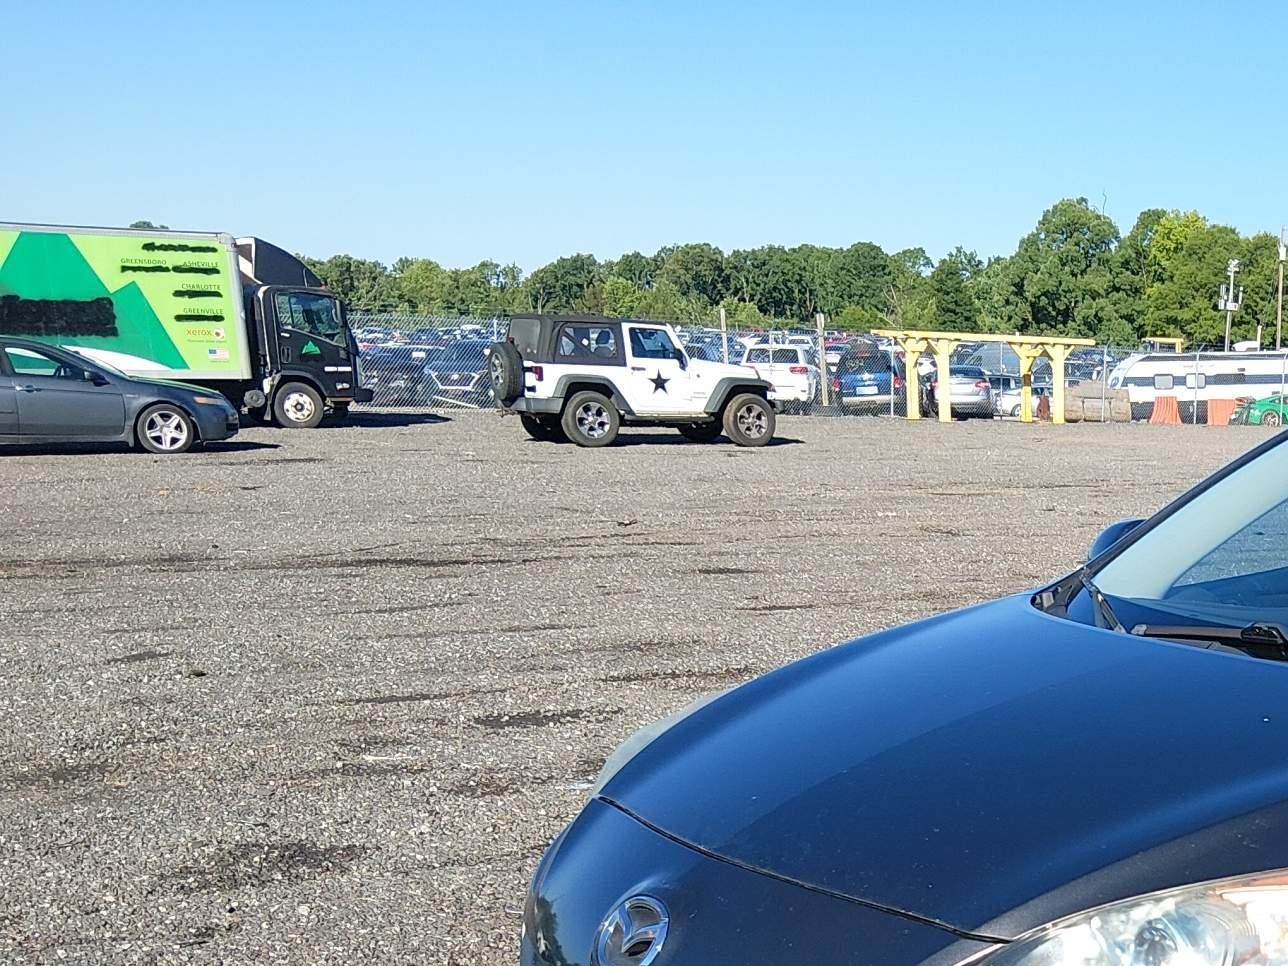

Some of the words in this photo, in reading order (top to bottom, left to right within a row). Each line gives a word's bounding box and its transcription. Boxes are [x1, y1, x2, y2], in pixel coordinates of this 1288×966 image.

[120, 257, 167, 266] GREENSBORO
[181, 283, 221, 291] CHARLOTTE
[183, 307, 224, 315] GREENVILLE
[186, 328, 212, 336] xerox
